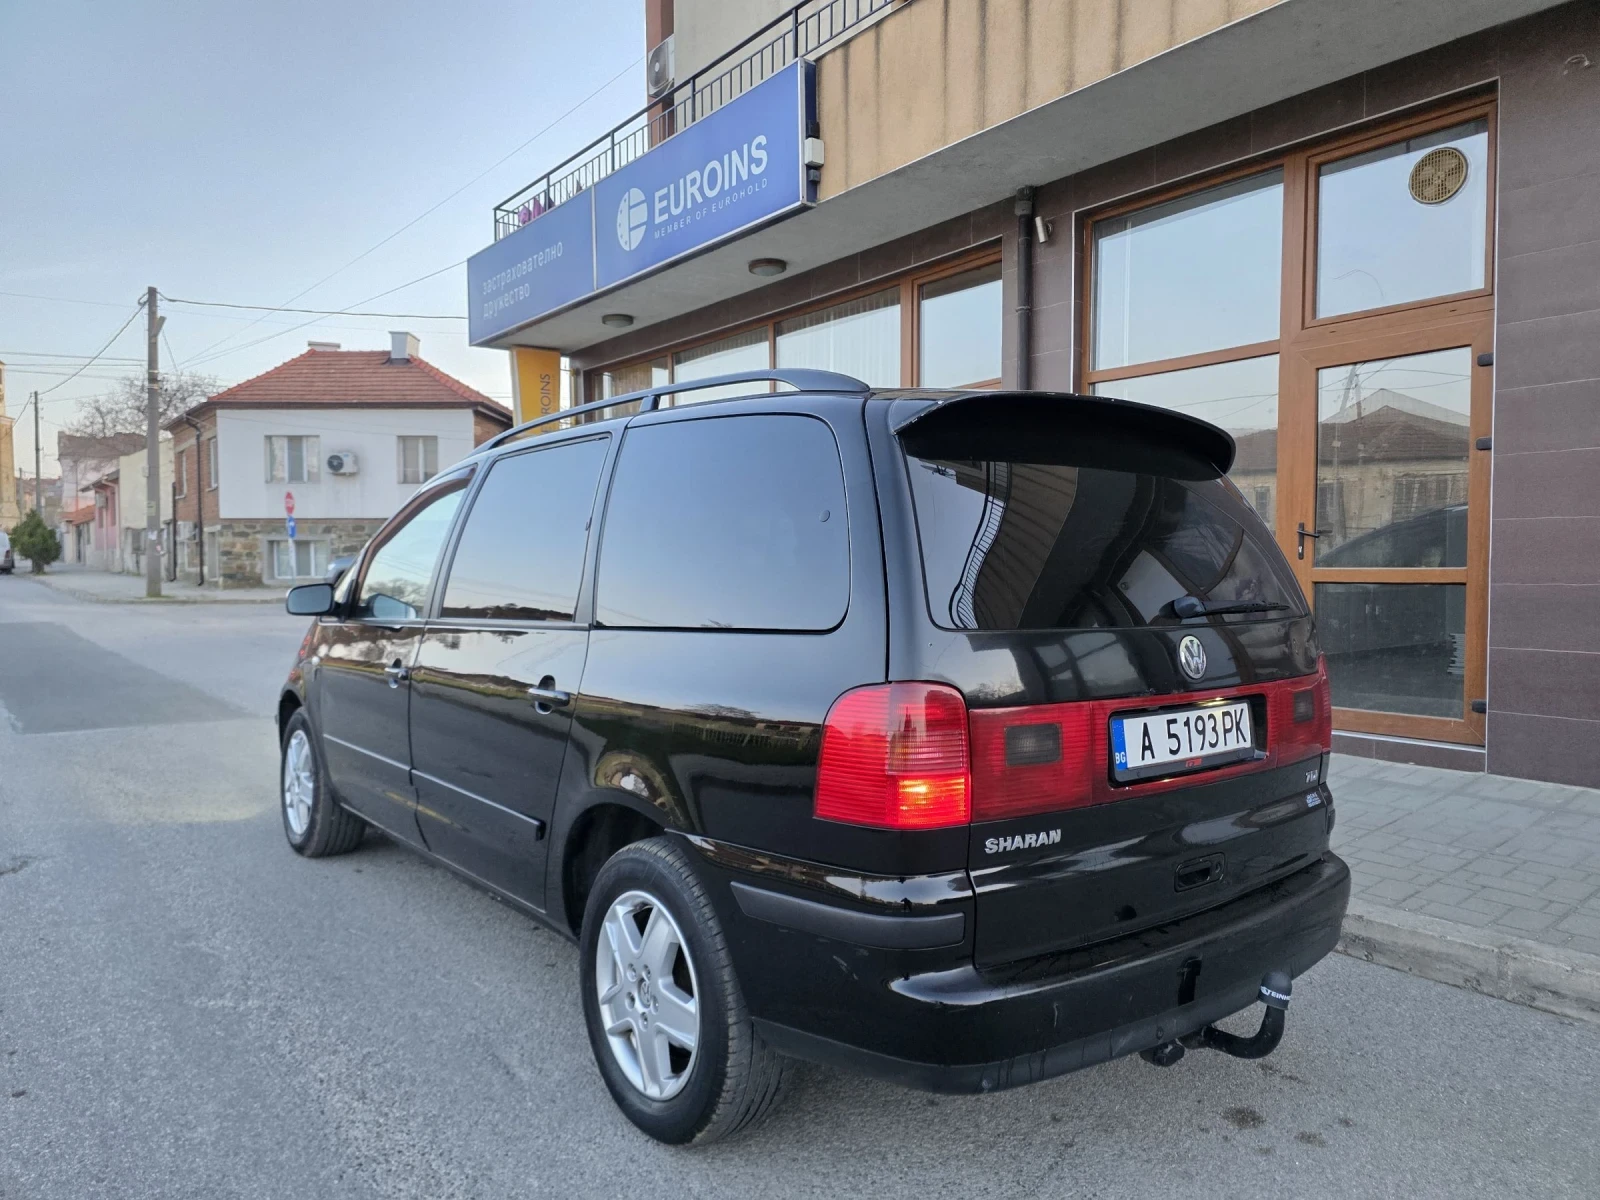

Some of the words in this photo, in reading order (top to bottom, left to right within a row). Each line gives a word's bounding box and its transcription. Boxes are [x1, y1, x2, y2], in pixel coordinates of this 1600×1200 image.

[654, 135, 768, 224] EUROINS
[654, 215, 691, 239] MEMBER
[696, 208, 707, 220] OF
[712, 178, 768, 212] EUROHOLD
[483, 241, 563, 295] застрахователно
[483, 283, 530, 320] дружество
[1115, 752, 1126, 764] BG
[1141, 722, 1155, 761] A
[984, 828, 1062, 854] SHARAN
